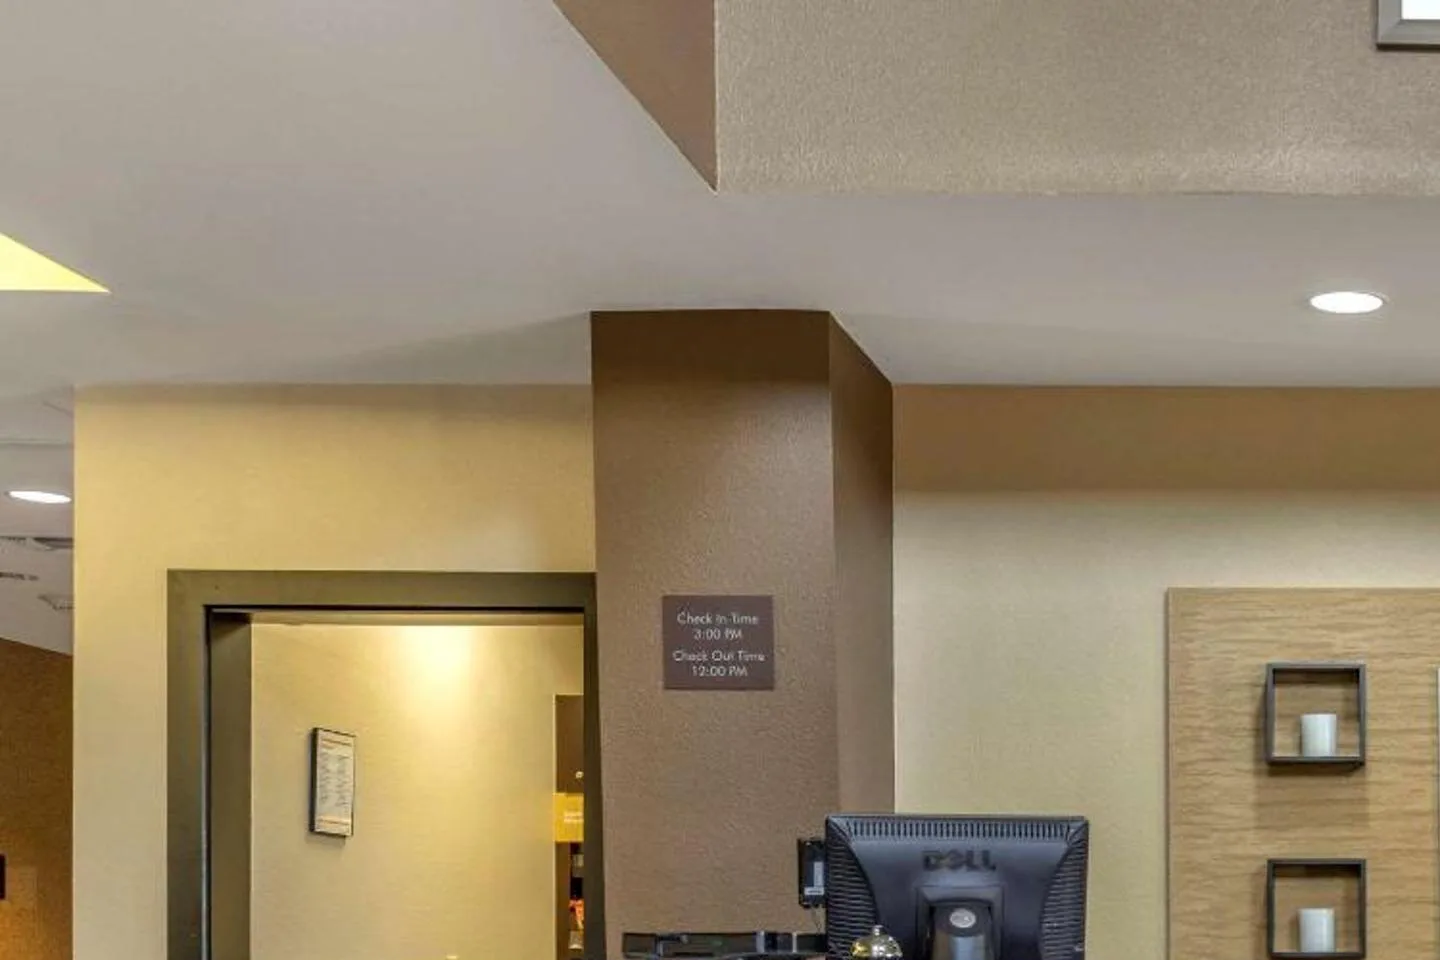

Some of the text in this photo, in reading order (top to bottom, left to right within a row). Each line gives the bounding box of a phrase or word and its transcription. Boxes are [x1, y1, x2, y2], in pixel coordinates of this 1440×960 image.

[677, 612, 712, 624] Check
[731, 612, 758, 624] Time
[693, 628, 742, 640] 3:00 PM
[672, 650, 765, 661] Check Out Time
[692, 665, 748, 677] 12:00 PM
[922, 850, 996, 872] DELL
